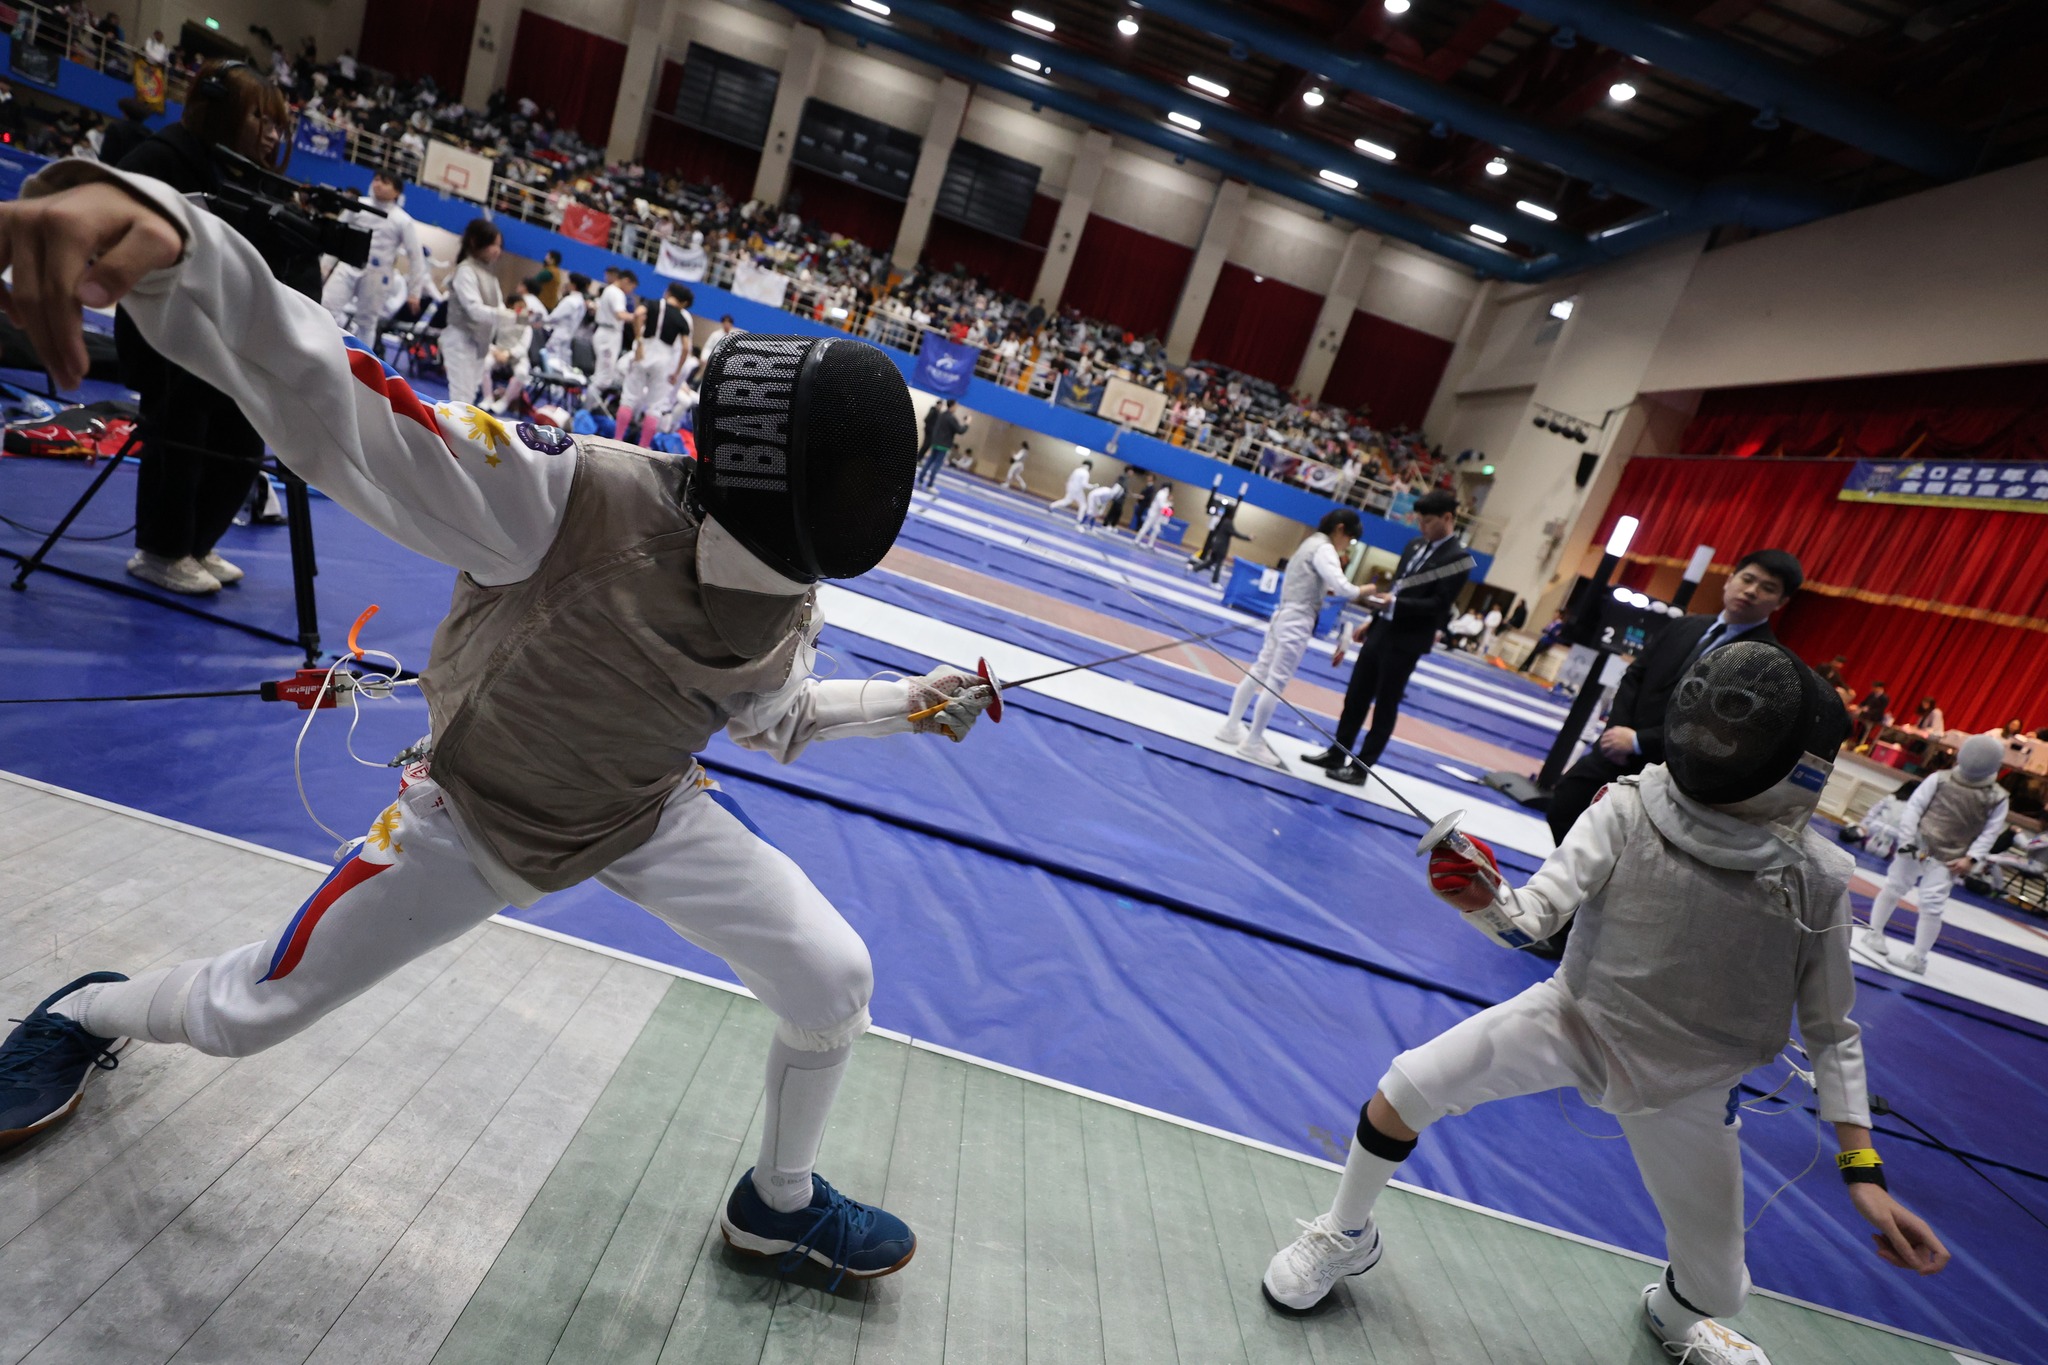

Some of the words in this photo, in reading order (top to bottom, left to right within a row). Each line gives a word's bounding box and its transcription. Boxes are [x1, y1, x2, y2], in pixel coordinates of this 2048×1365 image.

[714, 339, 813, 493] IBARRA
[1601, 626, 1615, 644] 2
[285, 685, 318, 696] allstar
